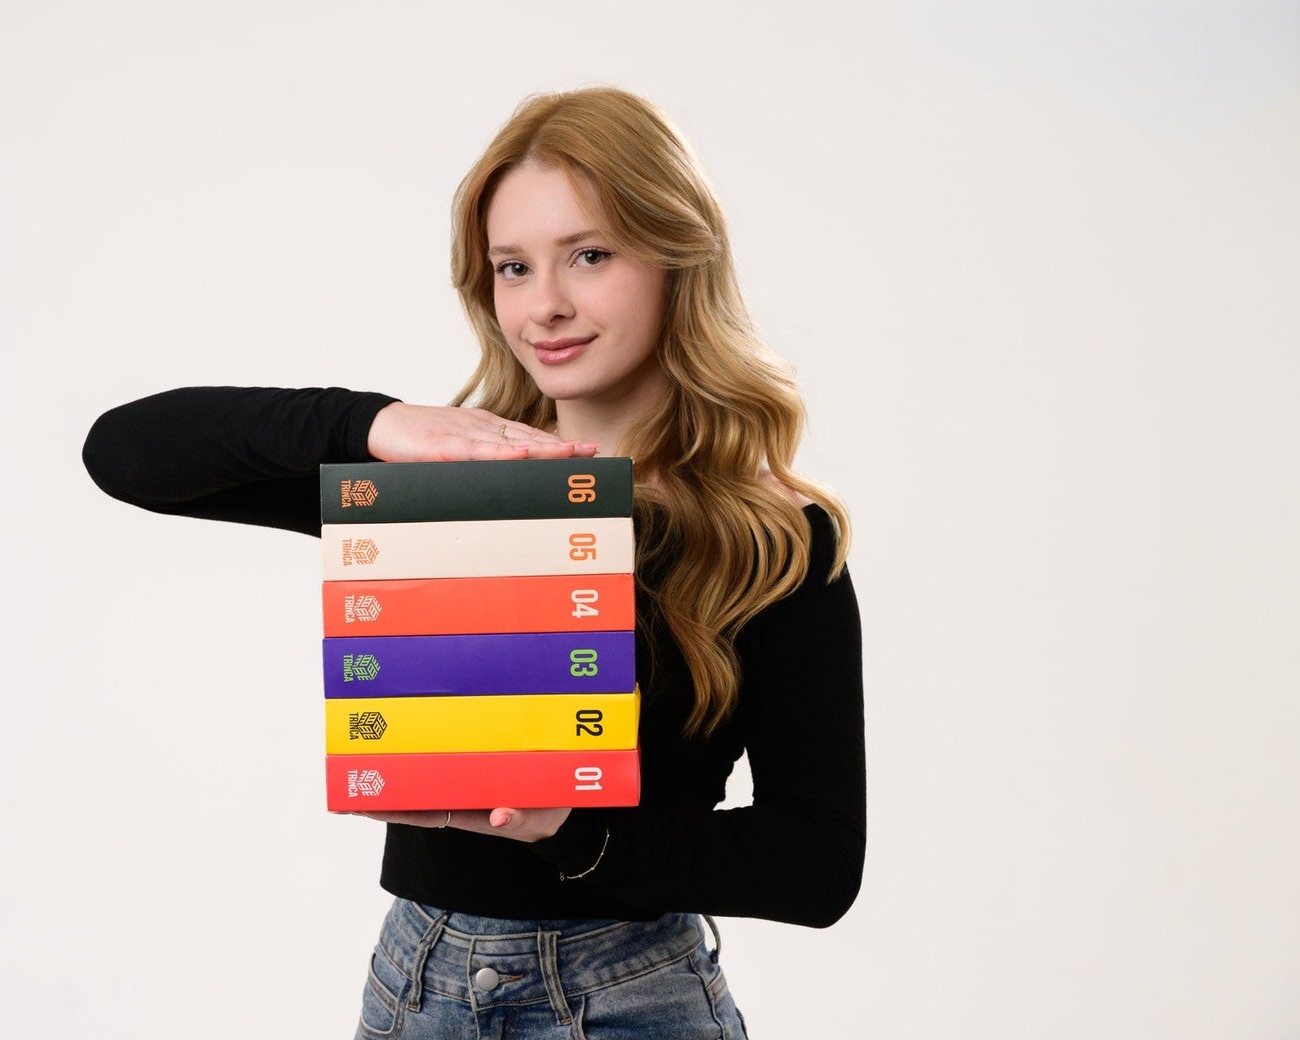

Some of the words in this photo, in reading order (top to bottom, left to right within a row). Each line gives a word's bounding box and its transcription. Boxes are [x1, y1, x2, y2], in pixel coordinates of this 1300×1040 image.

[341, 480, 351, 508] TRINCA
[568, 474, 596, 503] 06
[342, 539, 353, 566] TRINCA
[569, 533, 597, 562] 05
[345, 595, 355, 623] TRINCA
[571, 590, 598, 618] 04
[343, 654, 353, 682] TRINCA
[570, 649, 597, 677] 03
[349, 712, 359, 740] TRINCA
[576, 709, 603, 737] 02
[348, 769, 358, 797] TRINCA
[575, 767, 602, 791] 01
